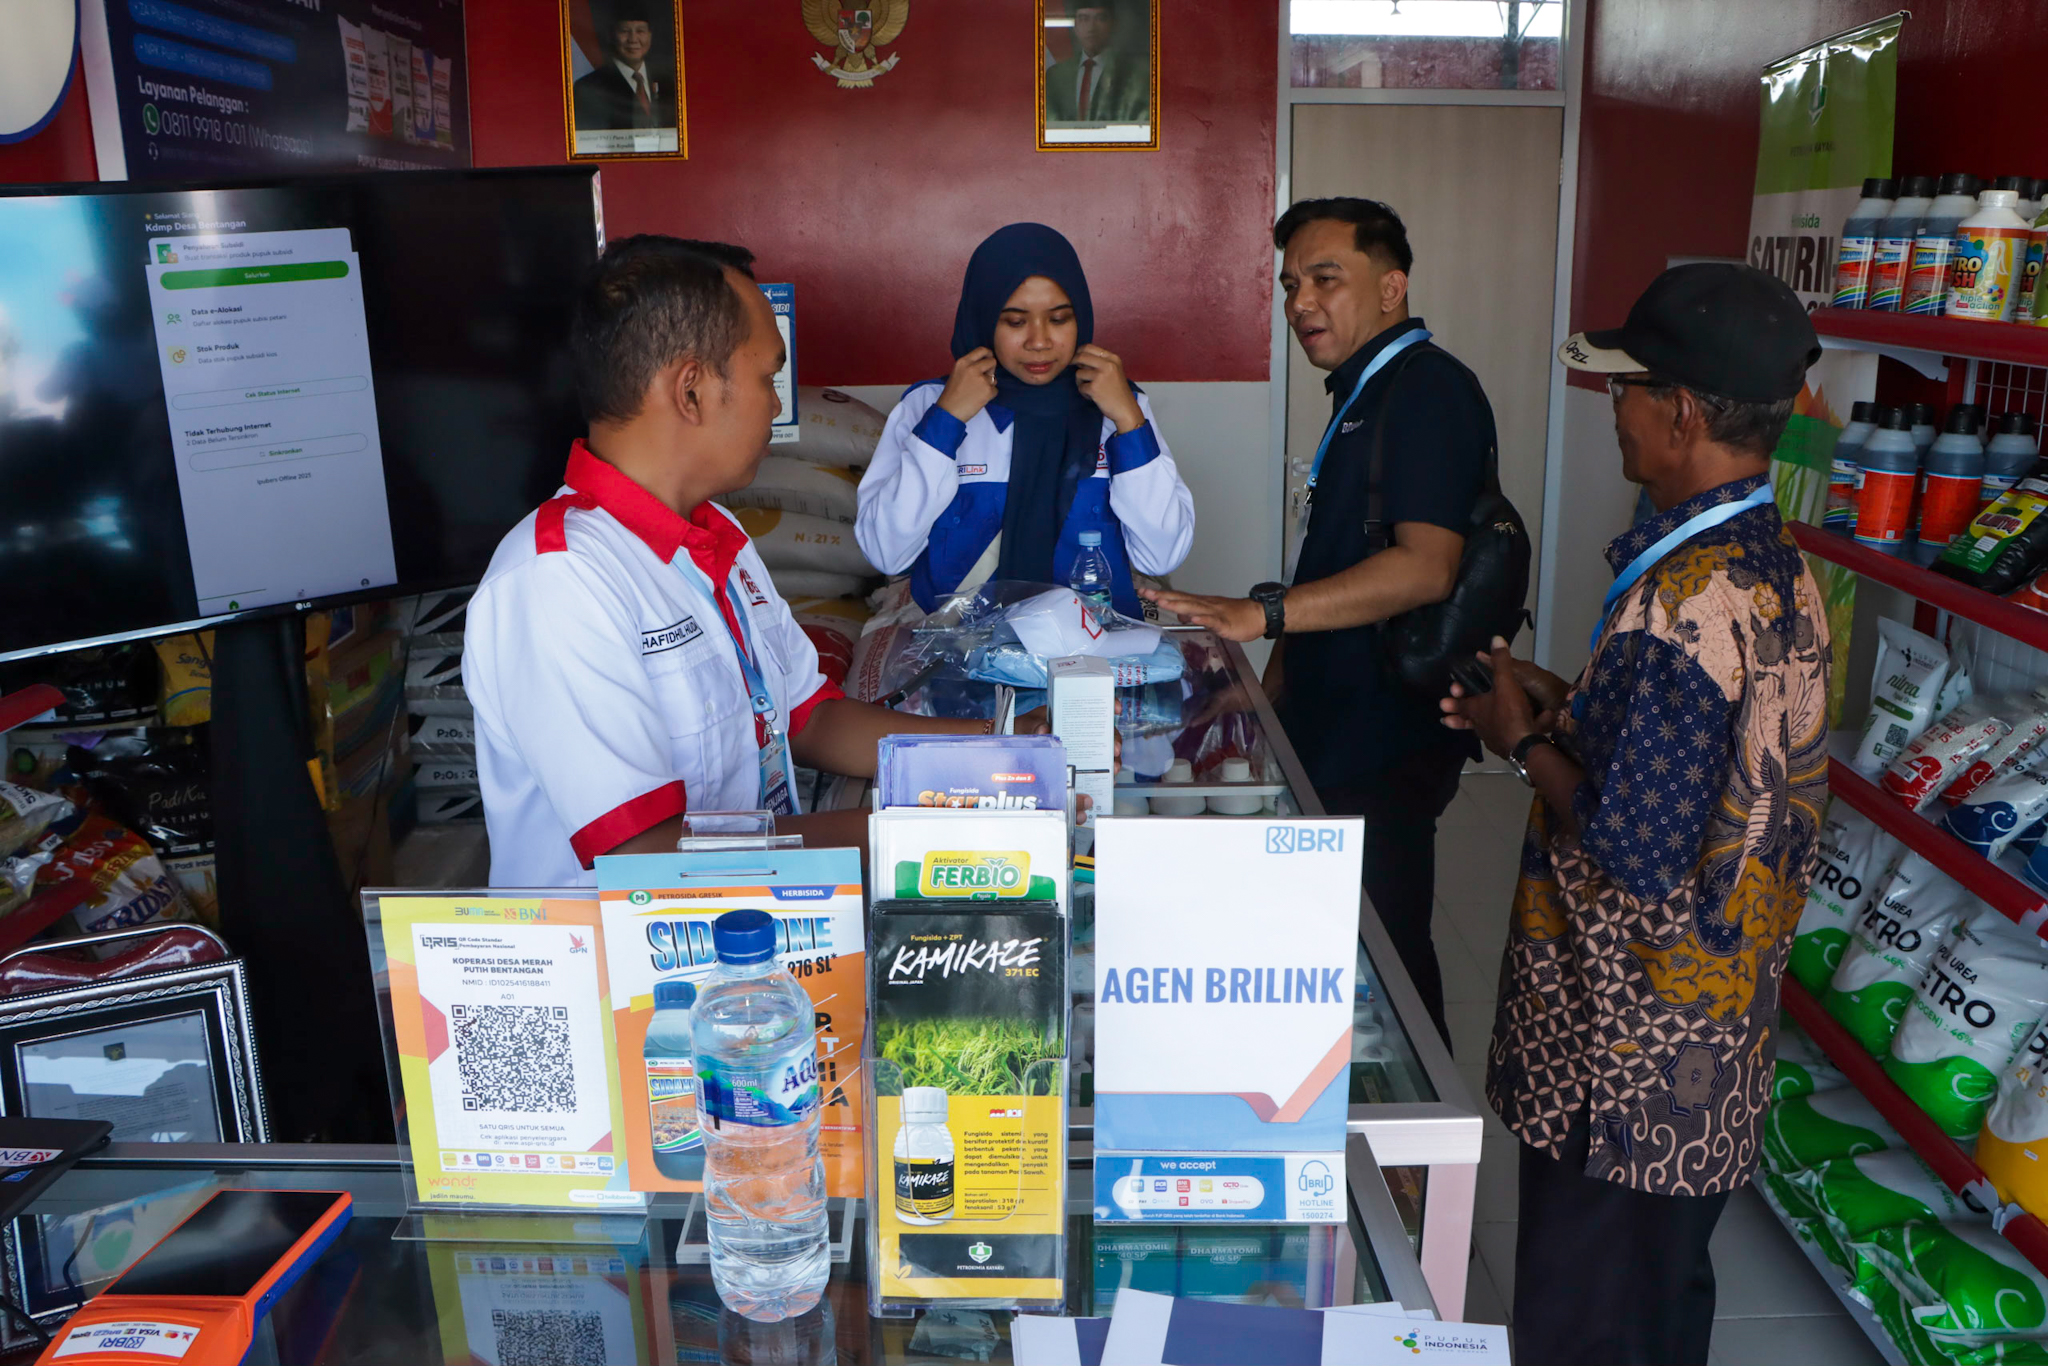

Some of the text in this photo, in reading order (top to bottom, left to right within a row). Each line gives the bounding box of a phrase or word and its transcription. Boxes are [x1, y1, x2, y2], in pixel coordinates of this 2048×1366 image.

[138, 75, 244, 114] Layanan Pelanggan
[160, 110, 314, 157] 0811 9918 001 (Whatsapp)
[145, 220, 247, 233] Kdmp Desa Bentangan
[192, 306, 243, 316] Data e-Alokasi
[214, 343, 240, 352] Produk
[1566, 342, 1589, 365] OPEL
[184, 421, 272, 438] Tidak Terhubung Internet
[192, 438, 207, 446] Data
[268, 446, 303, 457] Sinkronkan
[958, 466, 984, 475] RILink
[278, 474, 297, 483] Offline
[794, 532, 841, 545] N 21 %
[642, 629, 686, 650] HAFIDHIL
[1887, 673, 1920, 698] nitrea
[950, 787, 979, 795] Fungisida
[918, 790, 1038, 810] Starplus
[1297, 828, 1344, 853] BRI
[933, 856, 969, 864] Aktivator
[931, 864, 1021, 888] FERBIO
[658, 892, 698, 900] PETROSIDA
[782, 888, 825, 897] HERBISIDA
[1884, 897, 1914, 918] UREA
[519, 908, 548, 921] BNI
[910, 934, 942, 942] Fungisida
[452, 958, 553, 967] KOPERASI DESA MERAH
[888, 938, 1042, 980] KAMIKAZE
[464, 966, 544, 975] PUTIH BENTANGAN
[1005, 968, 1039, 977] 371 EC
[1950, 956, 1979, 985] UREA
[1100, 967, 1345, 1004] AGEN BRILINK
[1950, 1028, 1975, 1047] 46%
[2015, 1066, 2030, 1082] 21
[964, 1161, 1049, 1169] mengendalikan penyakit
[1160, 1160, 1217, 1172] we accept
[428, 1175, 478, 1187] wondr
[898, 1170, 950, 1188] KAMIKAZE
[1308, 1179, 1324, 1189] BRI
[1299, 1199, 1334, 1207] HOTLINE
[1301, 1212, 1334, 1220] 1500274
[1097, 1243, 1170, 1252] DHARMATOMIL
[138, 1329, 160, 1337] VISA
[99, 1337, 124, 1348] BRI
[1424, 1335, 1488, 1343] PUPUK
[1425, 1341, 1488, 1350] INDONESIA
